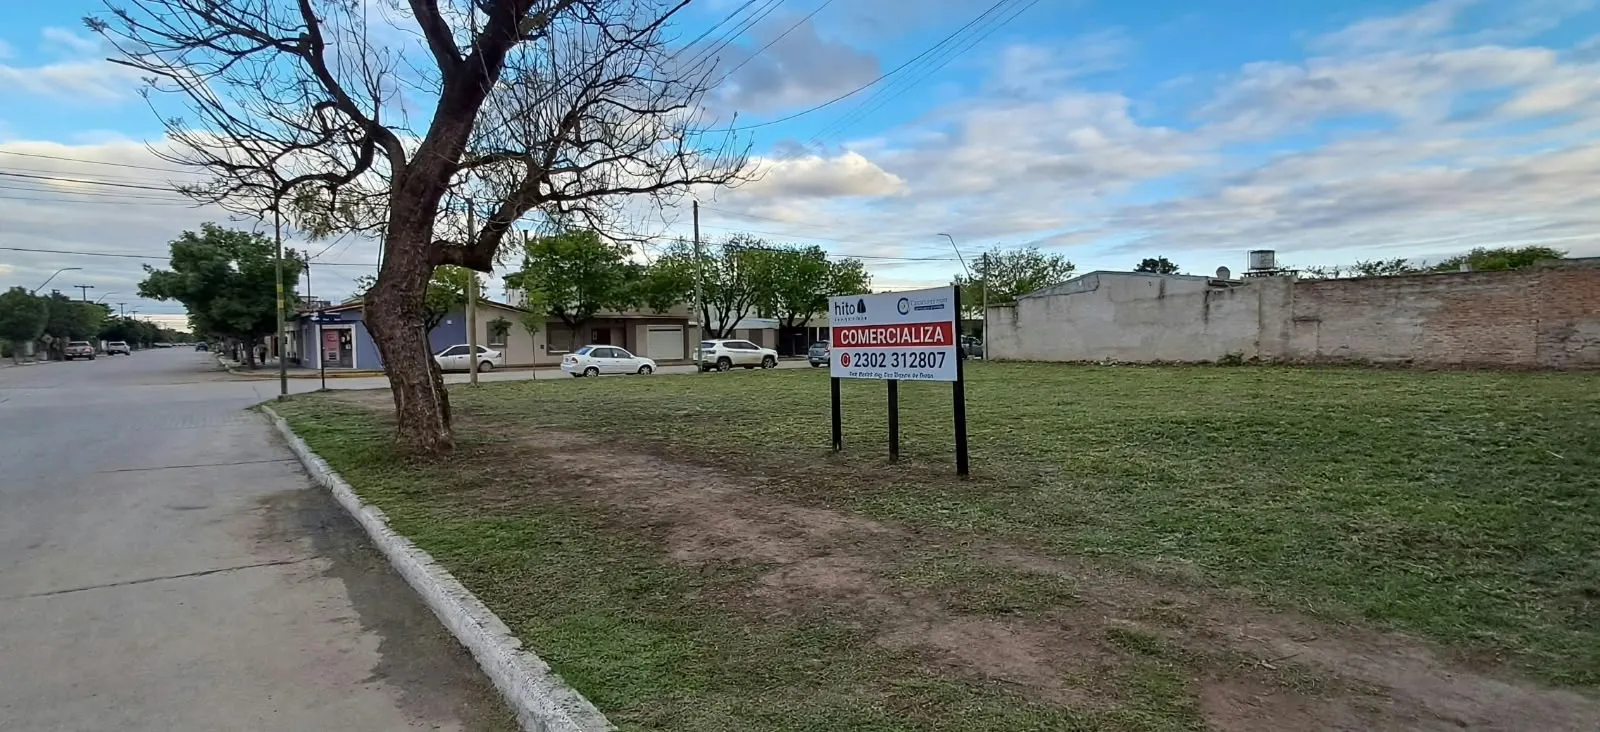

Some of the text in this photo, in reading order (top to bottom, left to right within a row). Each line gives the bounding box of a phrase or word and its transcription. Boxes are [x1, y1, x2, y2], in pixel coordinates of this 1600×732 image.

[834, 302, 855, 316] hito
[841, 326, 944, 345] COMERCIALIZA
[854, 352, 946, 368] 2302 312807
